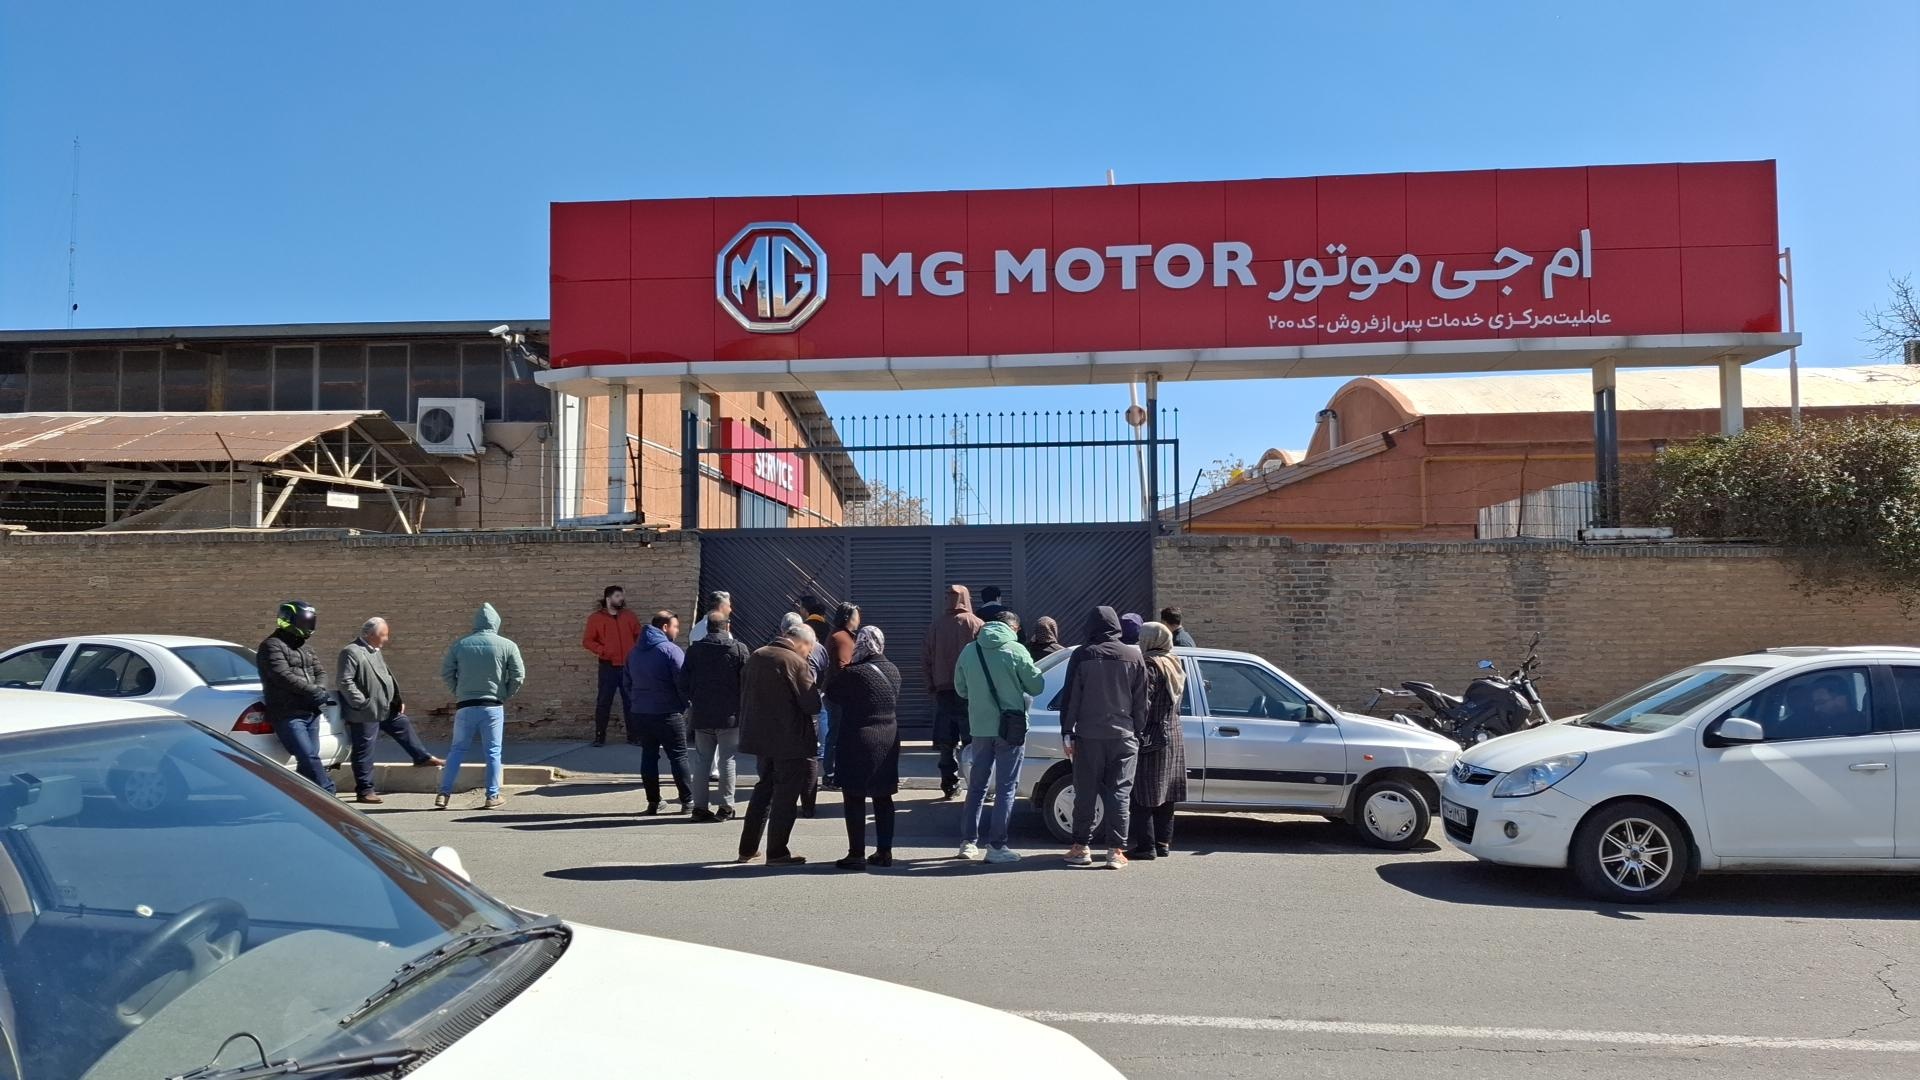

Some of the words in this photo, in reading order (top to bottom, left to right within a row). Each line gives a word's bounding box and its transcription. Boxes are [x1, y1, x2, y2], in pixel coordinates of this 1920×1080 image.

[731, 235, 812, 318] MG
[861, 251, 965, 297] MG
[994, 241, 1257, 294] MOTOR
[1267, 243, 1421, 302] موتور
[1431, 246, 1534, 300] جی
[1543, 229, 1592, 299] ام
[1268, 315, 1295, 330] ۲۰۰
[1296, 315, 1318, 329] کد
[1326, 314, 1380, 334] فروش
[1392, 319, 1423, 333] پس
[1426, 312, 1485, 328] خدمات
[1488, 309, 1553, 330] مرکزی
[754, 450, 794, 492] SERVICE
